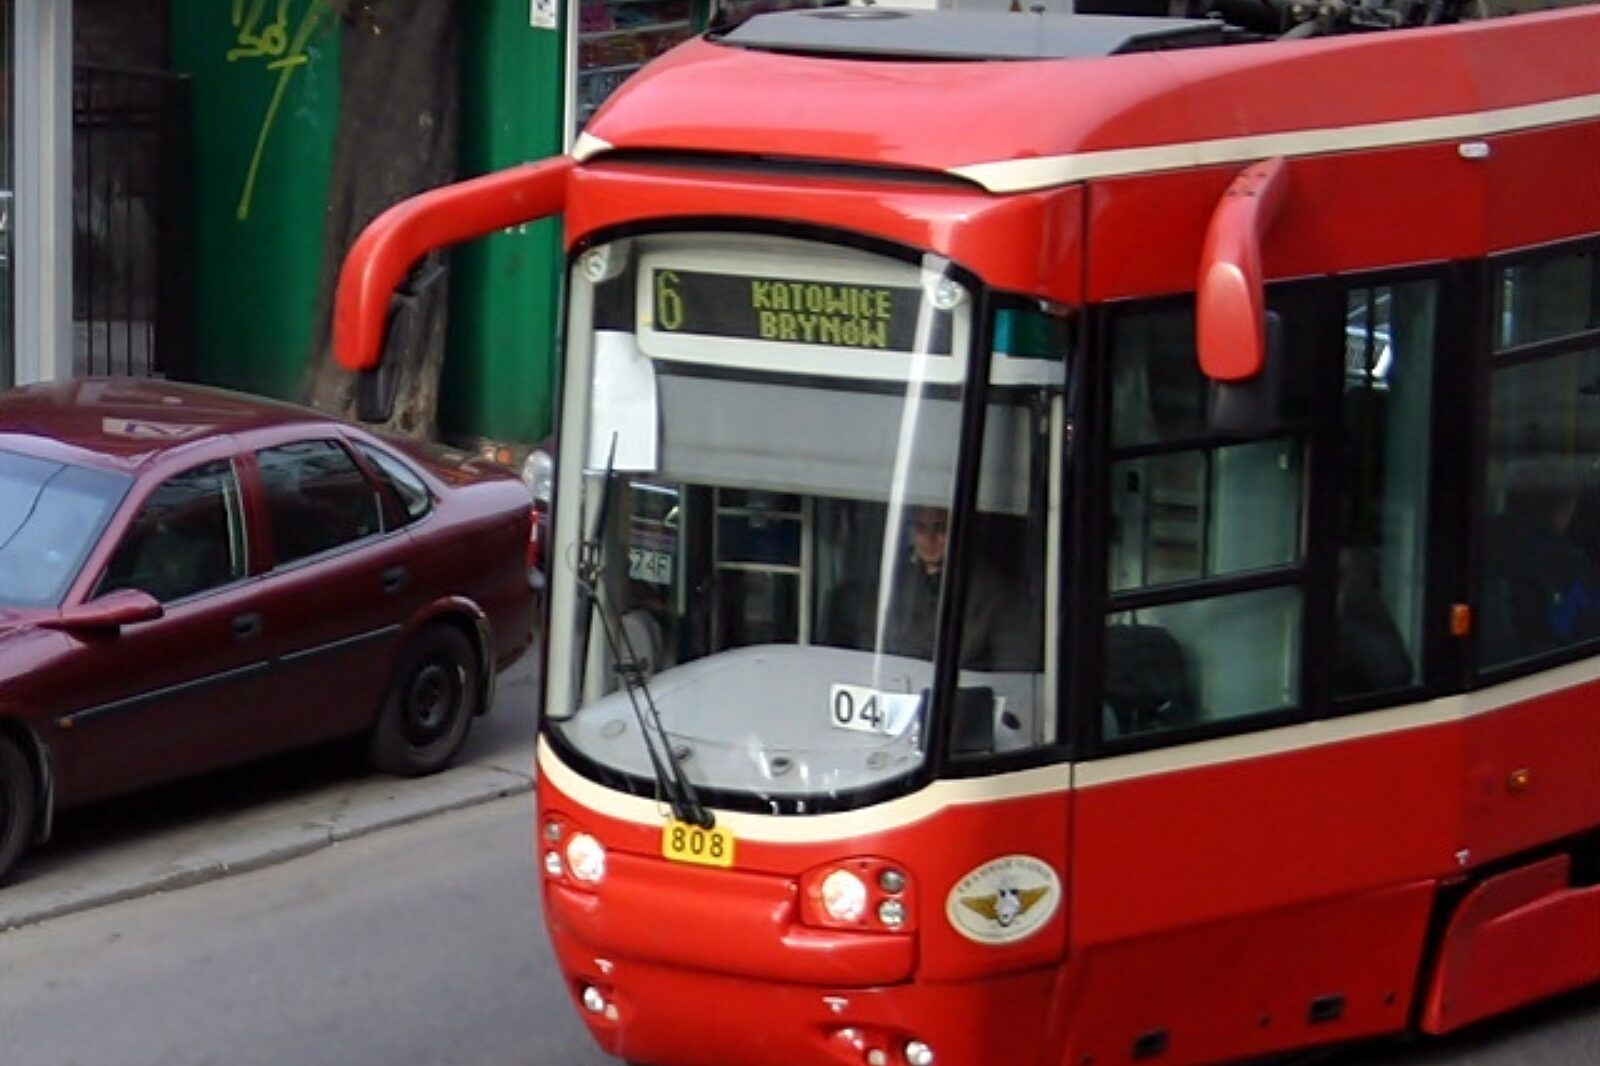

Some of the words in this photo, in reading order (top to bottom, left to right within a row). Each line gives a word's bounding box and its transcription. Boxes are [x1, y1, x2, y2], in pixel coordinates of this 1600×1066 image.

[656, 270, 682, 331] 6
[751, 280, 891, 319] KATOWICE
[834, 690, 881, 728] 04
[671, 826, 724, 858] 808
